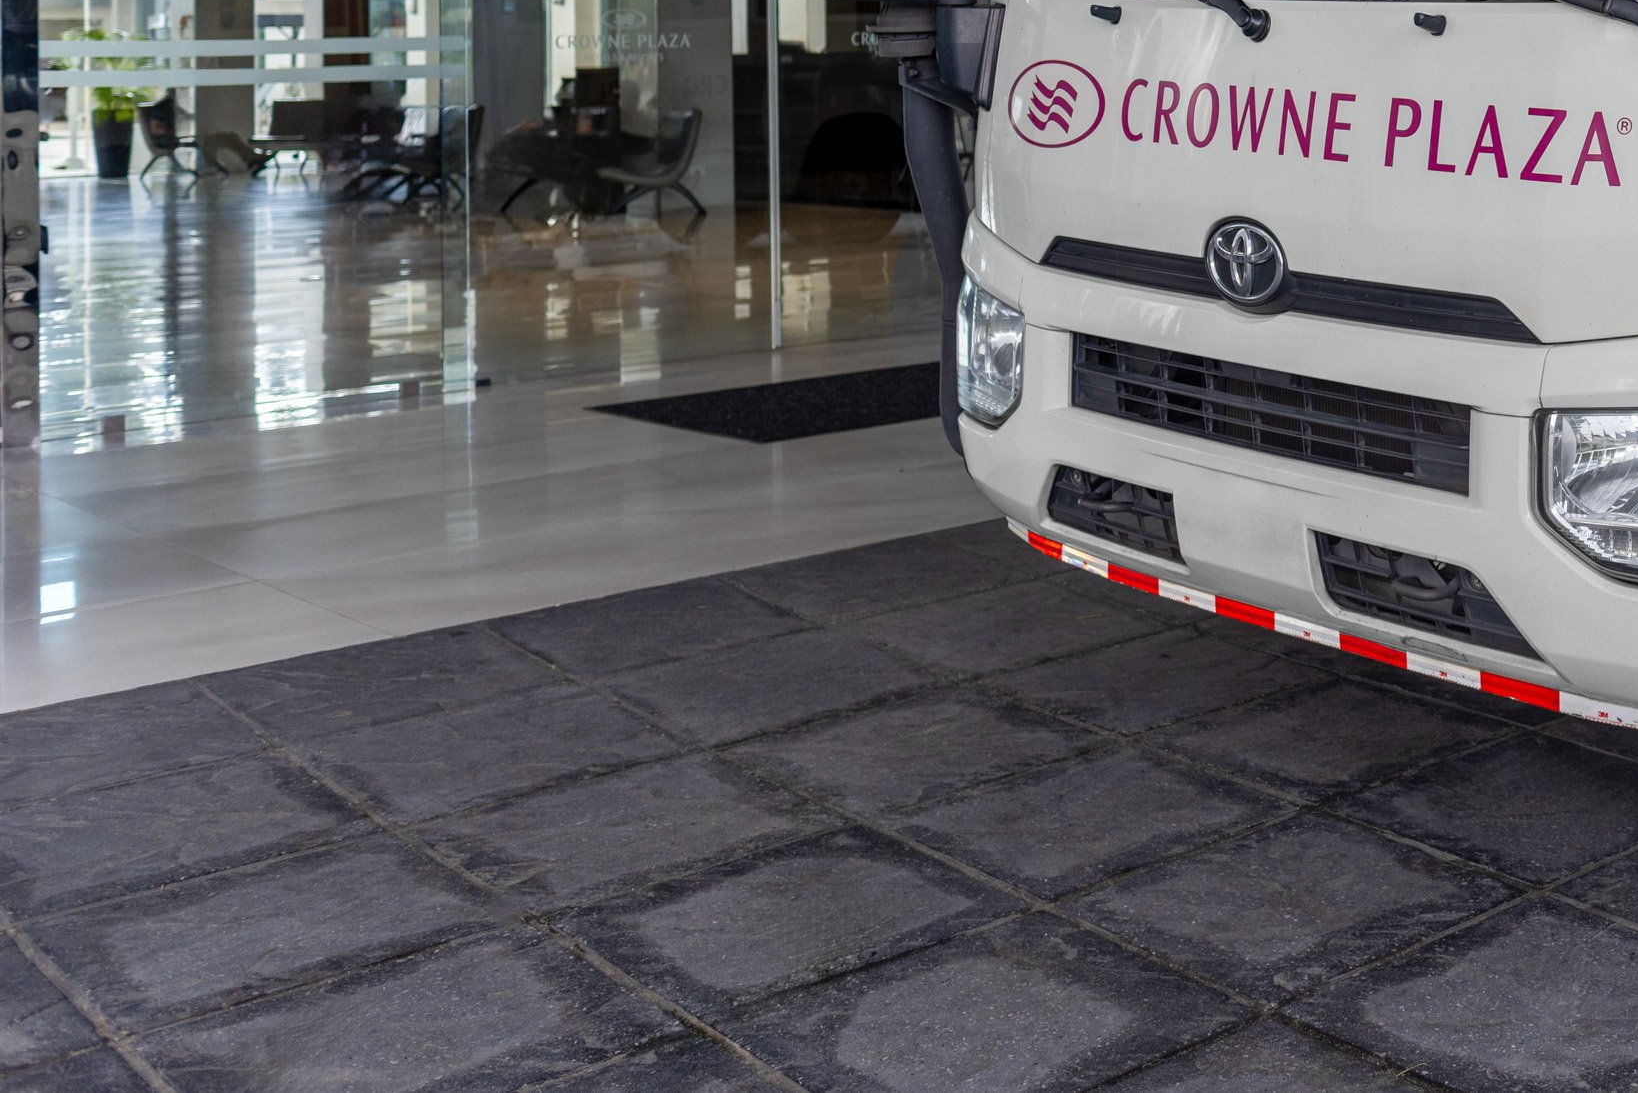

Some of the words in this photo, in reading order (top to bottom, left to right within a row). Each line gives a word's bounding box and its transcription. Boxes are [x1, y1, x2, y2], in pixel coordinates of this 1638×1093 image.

[555, 33, 630, 50] CROWNE
[638, 32, 691, 49] PLAZA
[1121, 78, 1357, 163] CROWNE
[1598, 710, 1609, 718] 3M
